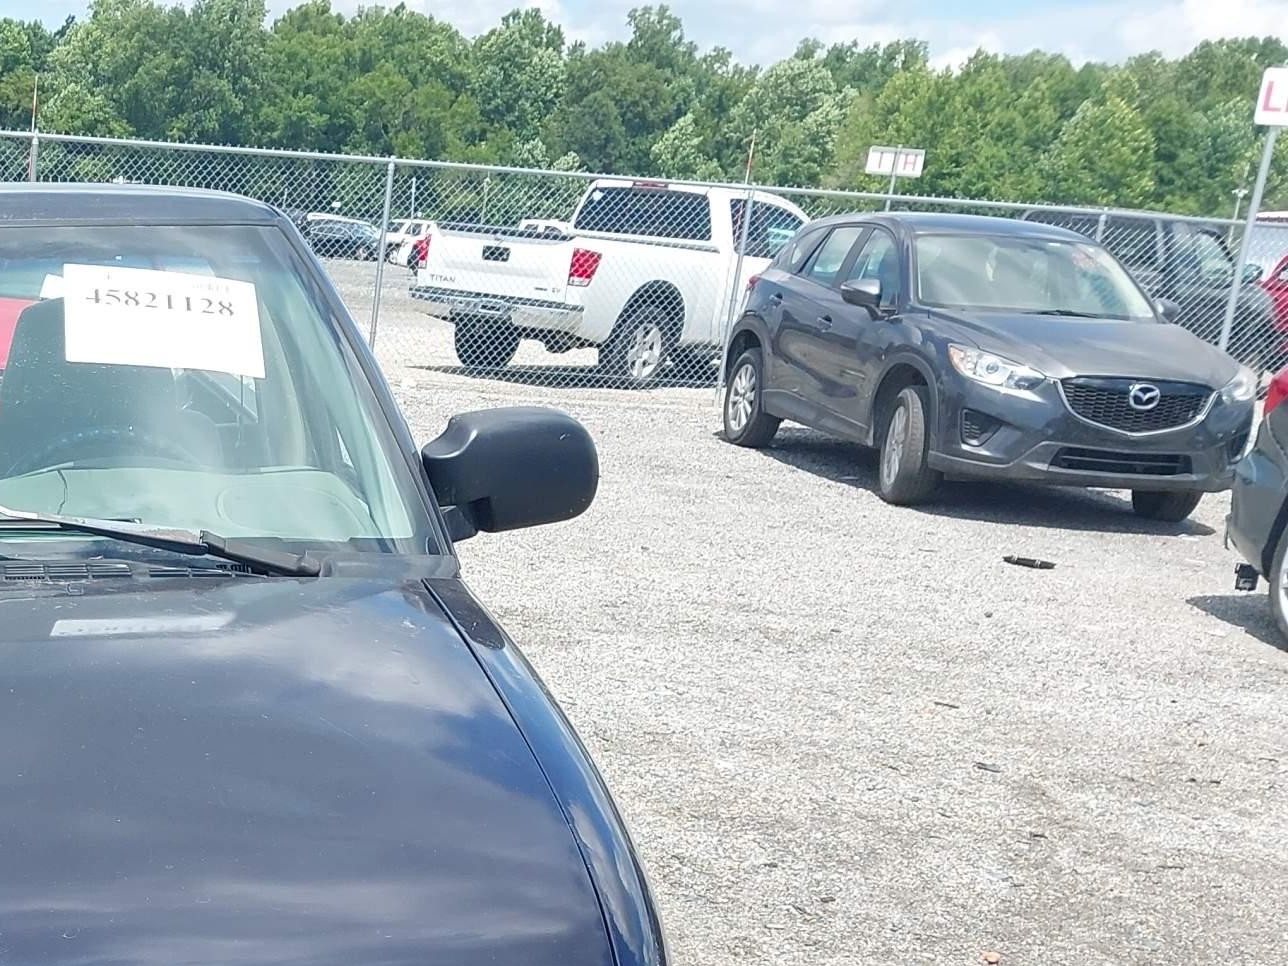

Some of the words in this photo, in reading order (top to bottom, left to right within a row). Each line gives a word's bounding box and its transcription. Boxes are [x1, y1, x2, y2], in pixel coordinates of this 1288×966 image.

[1263, 80, 1282, 112] L
[902, 153, 919, 172] H
[429, 273, 456, 283] TITAN
[85, 288, 235, 317] 45821128
